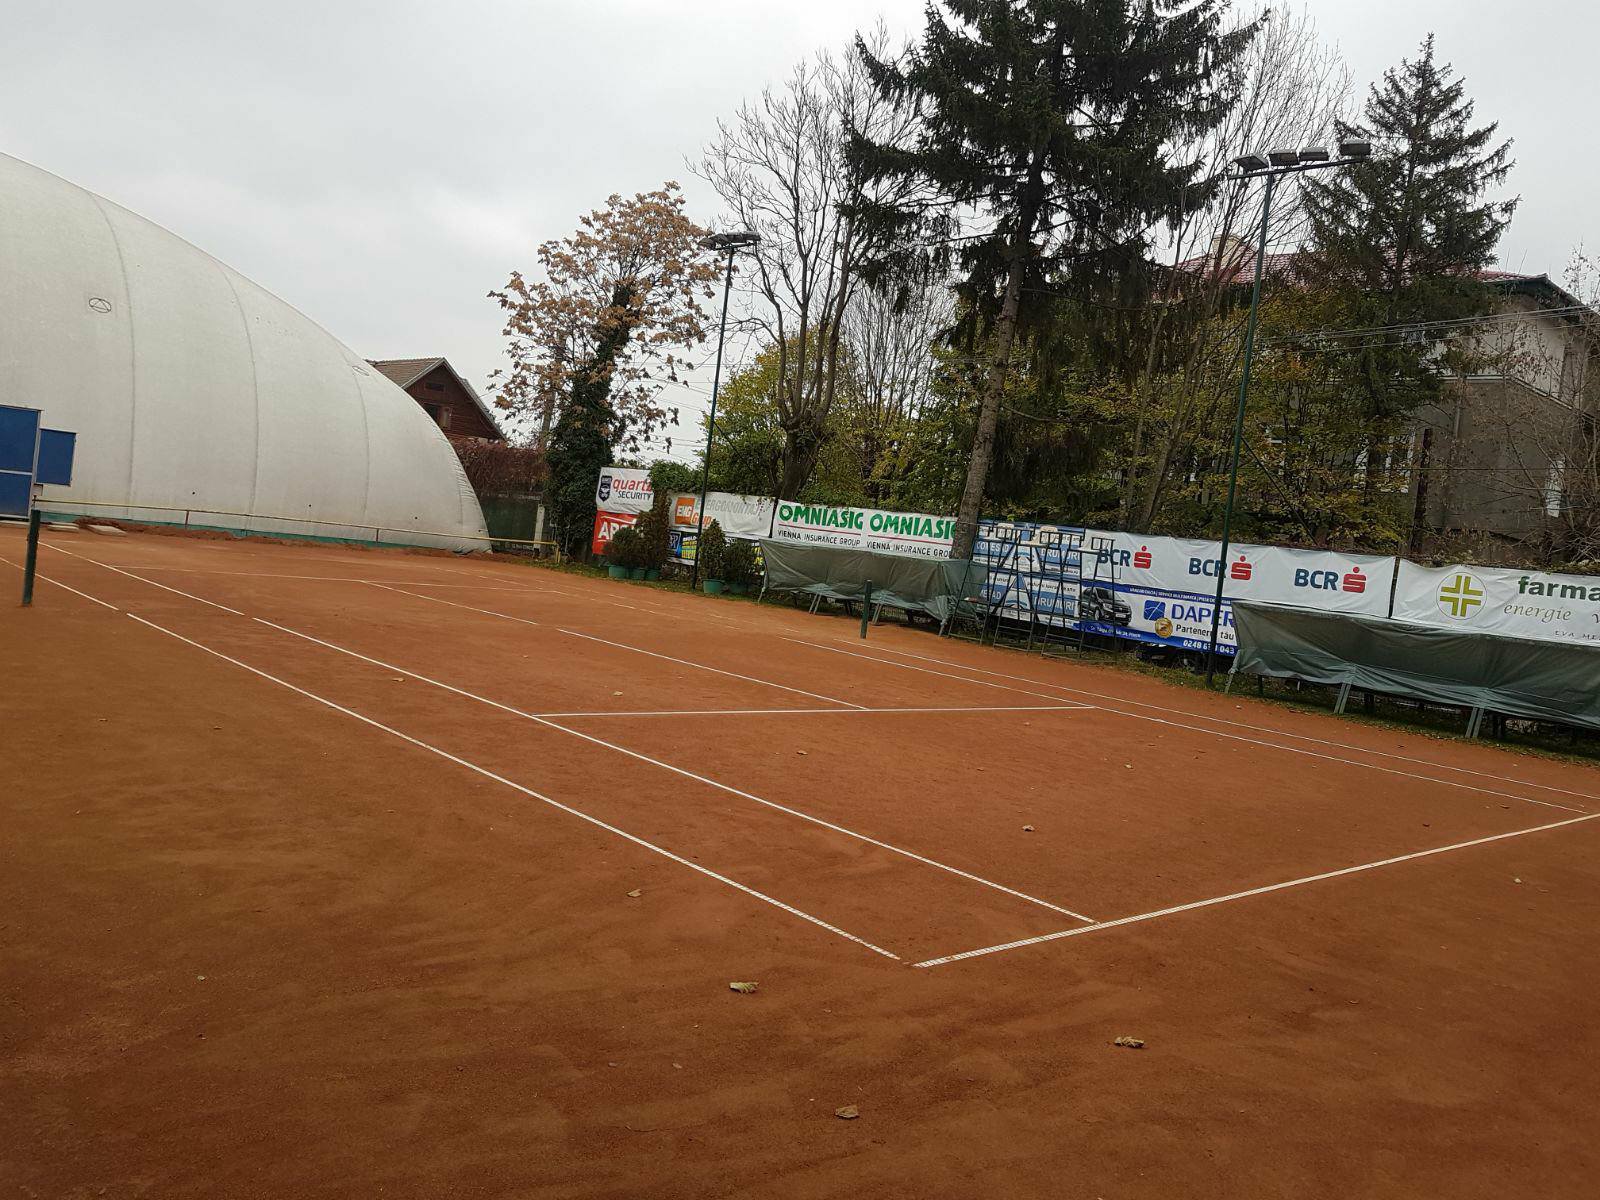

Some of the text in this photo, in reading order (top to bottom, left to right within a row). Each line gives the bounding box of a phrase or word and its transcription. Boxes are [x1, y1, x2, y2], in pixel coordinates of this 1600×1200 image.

[617, 491, 651, 500] SECURITY
[779, 504, 863, 530] OMNIASIG
[778, 529, 860, 548] VIENNA INSURANCE GROUP
[867, 541, 953, 558] VIENNA INSURANCE GROU
[1099, 549, 1131, 567] BCR
[1294, 568, 1339, 591] BCR
[1504, 604, 1571, 623] energie
[1176, 624, 1212, 637] Partener
[1219, 646, 1235, 655] 043
